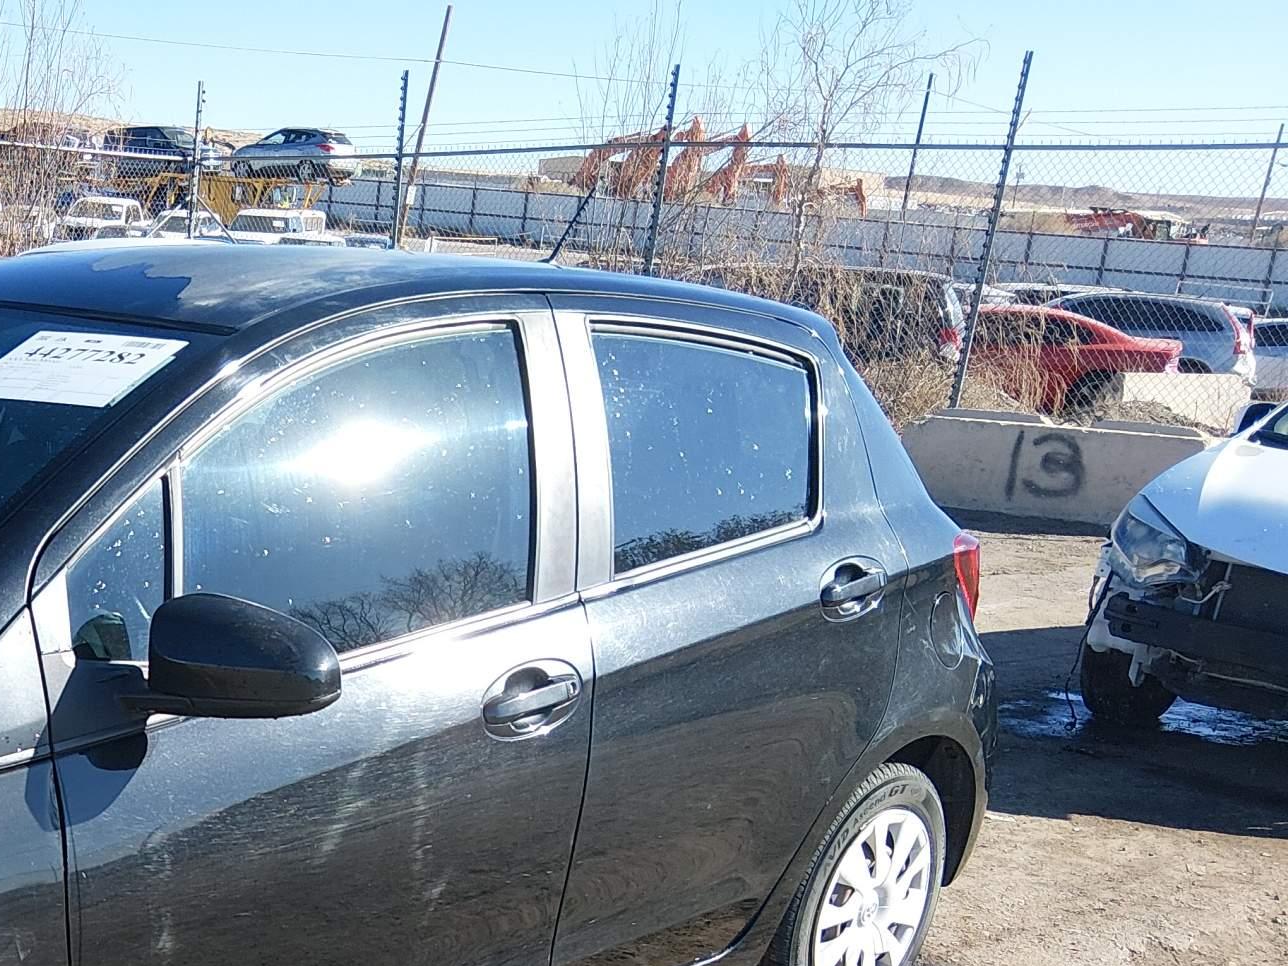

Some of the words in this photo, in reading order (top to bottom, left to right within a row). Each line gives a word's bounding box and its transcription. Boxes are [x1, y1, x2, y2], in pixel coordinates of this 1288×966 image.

[24, 345, 147, 365] 44277282
[1004, 430, 1085, 500] 13
[888, 783, 909, 798] GT
